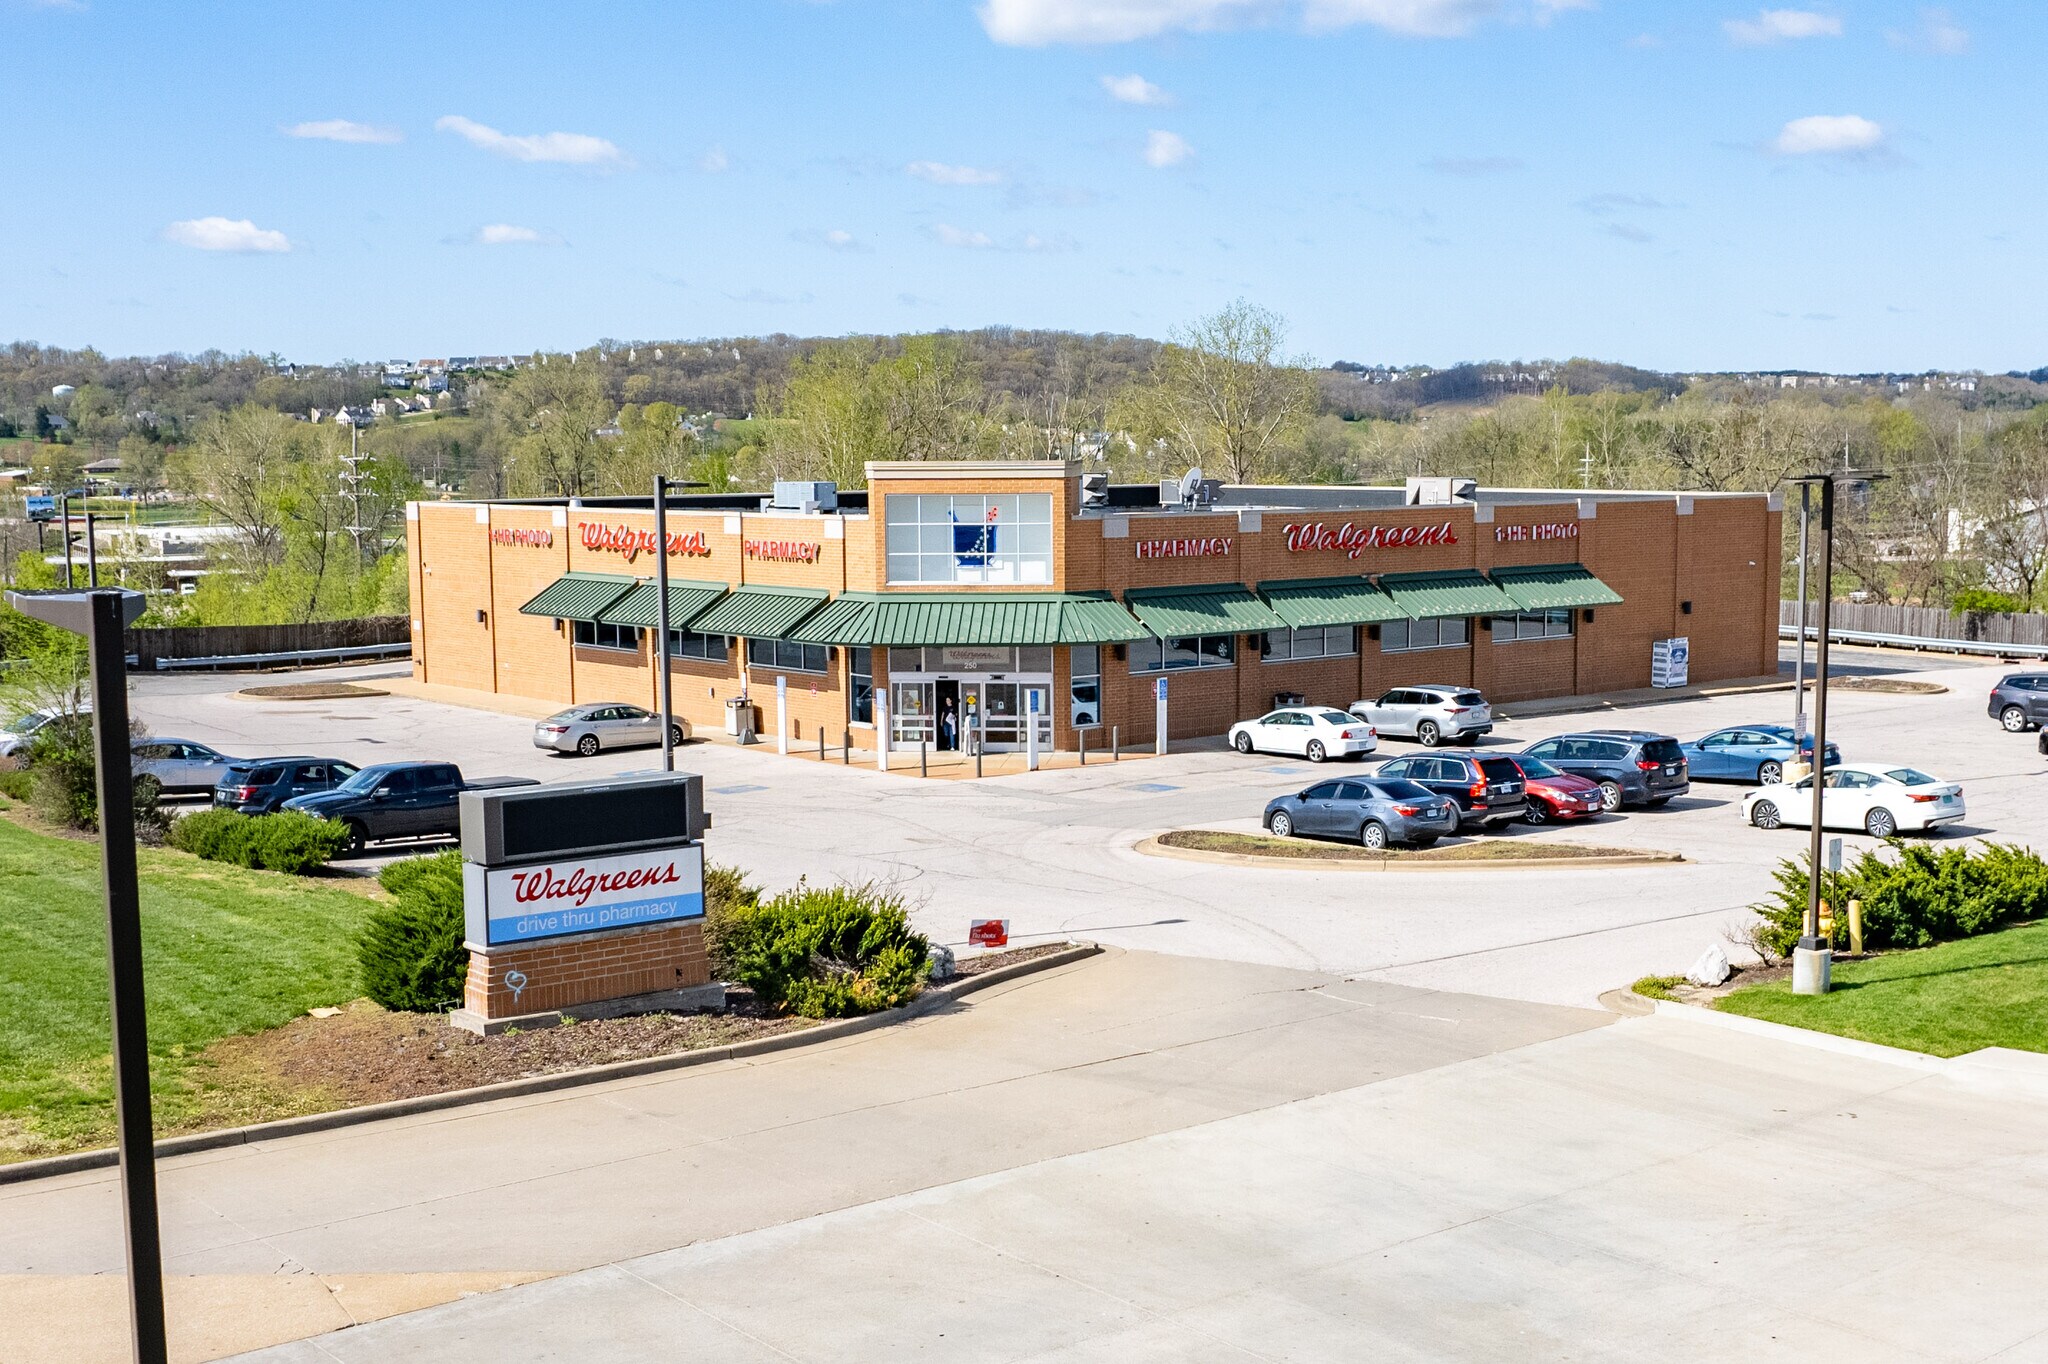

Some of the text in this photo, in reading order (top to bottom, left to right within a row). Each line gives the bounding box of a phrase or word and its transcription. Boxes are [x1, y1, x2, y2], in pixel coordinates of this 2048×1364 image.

[515, 529, 550, 545] PHOTO
[1282, 521, 1458, 560] Walgreens
[1495, 522, 1579, 541] 1-HR PHOTO
[744, 540, 817, 559] PHARMACY
[1136, 538, 1232, 559] PHARMACY
[511, 862, 681, 906] Walgreens
[517, 901, 677, 934] drive thru pharmacy
